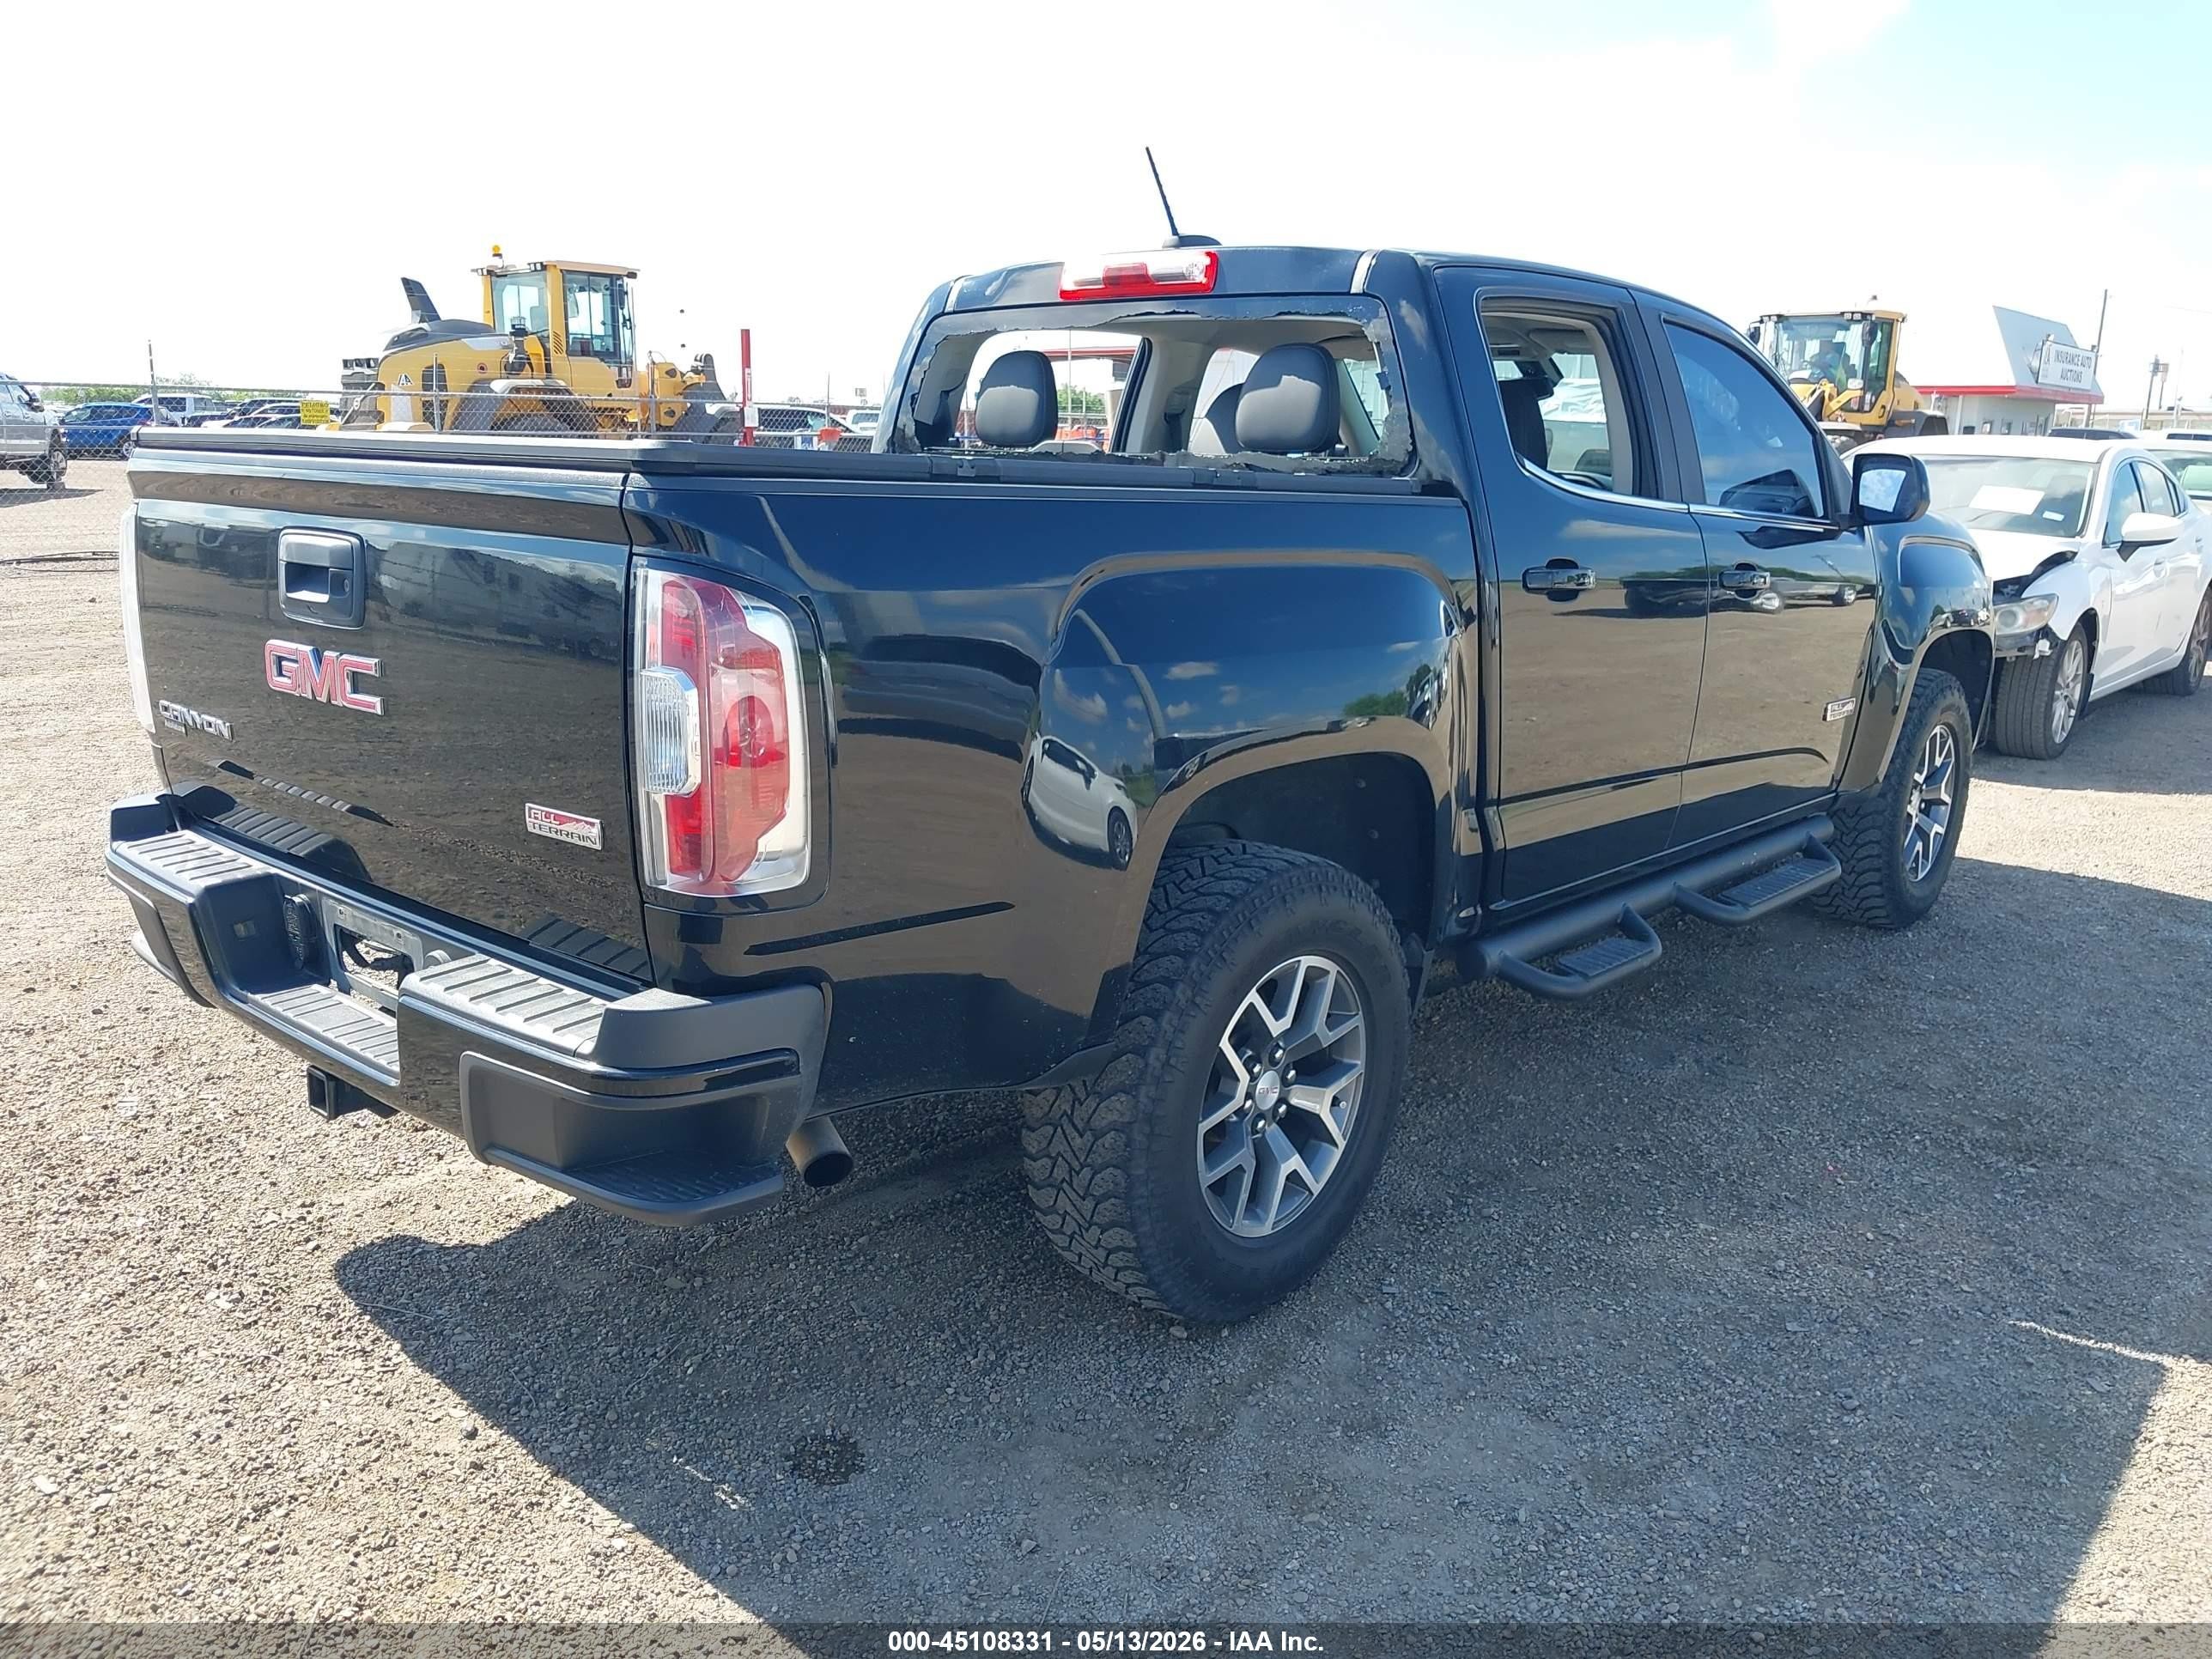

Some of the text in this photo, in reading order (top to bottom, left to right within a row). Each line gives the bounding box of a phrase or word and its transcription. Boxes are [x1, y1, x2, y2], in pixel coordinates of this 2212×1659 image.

[2054, 349, 2080, 367] INSURANCE
[2081, 355, 2093, 369] AUTO
[2061, 367, 2083, 384] AUCTIONS
[265, 639, 385, 716] GMC
[159, 700, 234, 740] CANYON
[530, 809, 560, 825] ALL
[528, 821, 598, 846] TERRAIN
[1258, 1086, 1279, 1095] GMC
